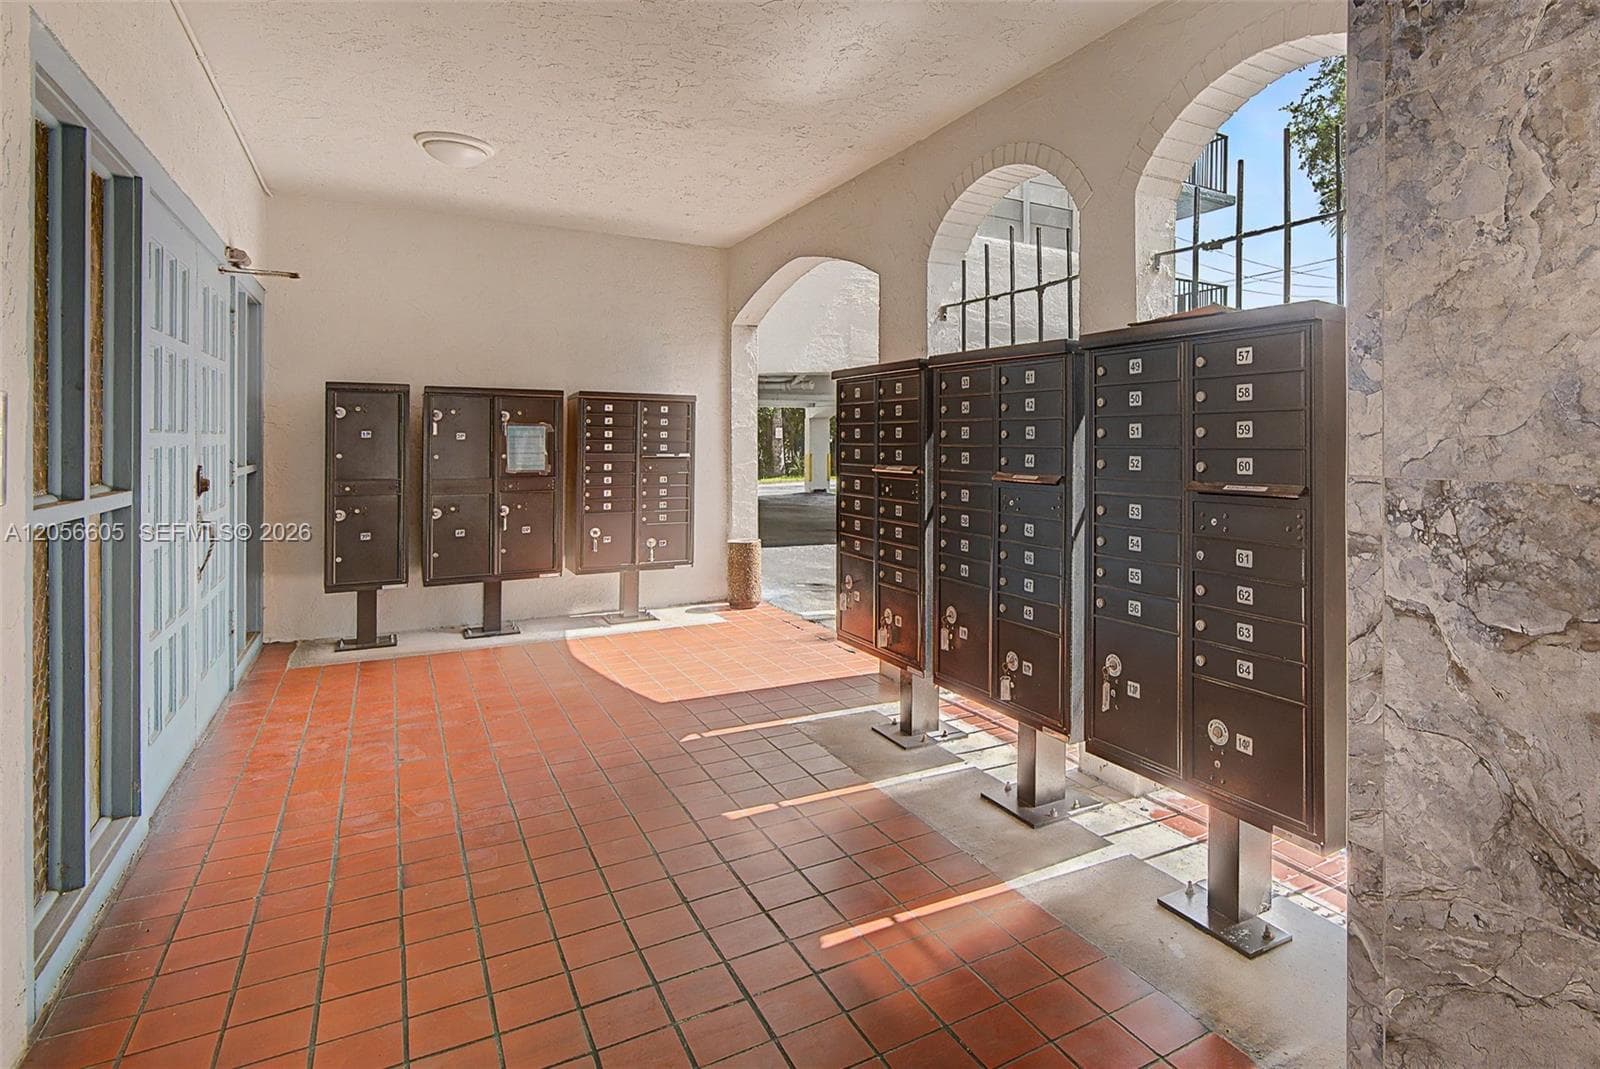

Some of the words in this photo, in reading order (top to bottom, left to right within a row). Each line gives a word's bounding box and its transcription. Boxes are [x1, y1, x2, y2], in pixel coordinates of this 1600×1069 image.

[1238, 350, 1250, 362] 57
[1130, 360, 1140, 372] 49
[1130, 393, 1140, 404] 50
[1238, 387, 1250, 399] 58
[1130, 426, 1140, 436] 51
[1238, 424, 1250, 435] 59
[1130, 458, 1140, 469] 52
[1238, 460, 1251, 472] 60
[1130, 506, 1140, 517] 53
[1130, 538, 1140, 550] 54
[1237, 553, 1249, 564] 61
[1130, 571, 1140, 582] 55
[1238, 590, 1251, 602] 62
[1129, 603, 1139, 614] 56
[1238, 627, 1250, 639] 63
[1238, 664, 1250, 676] 64
